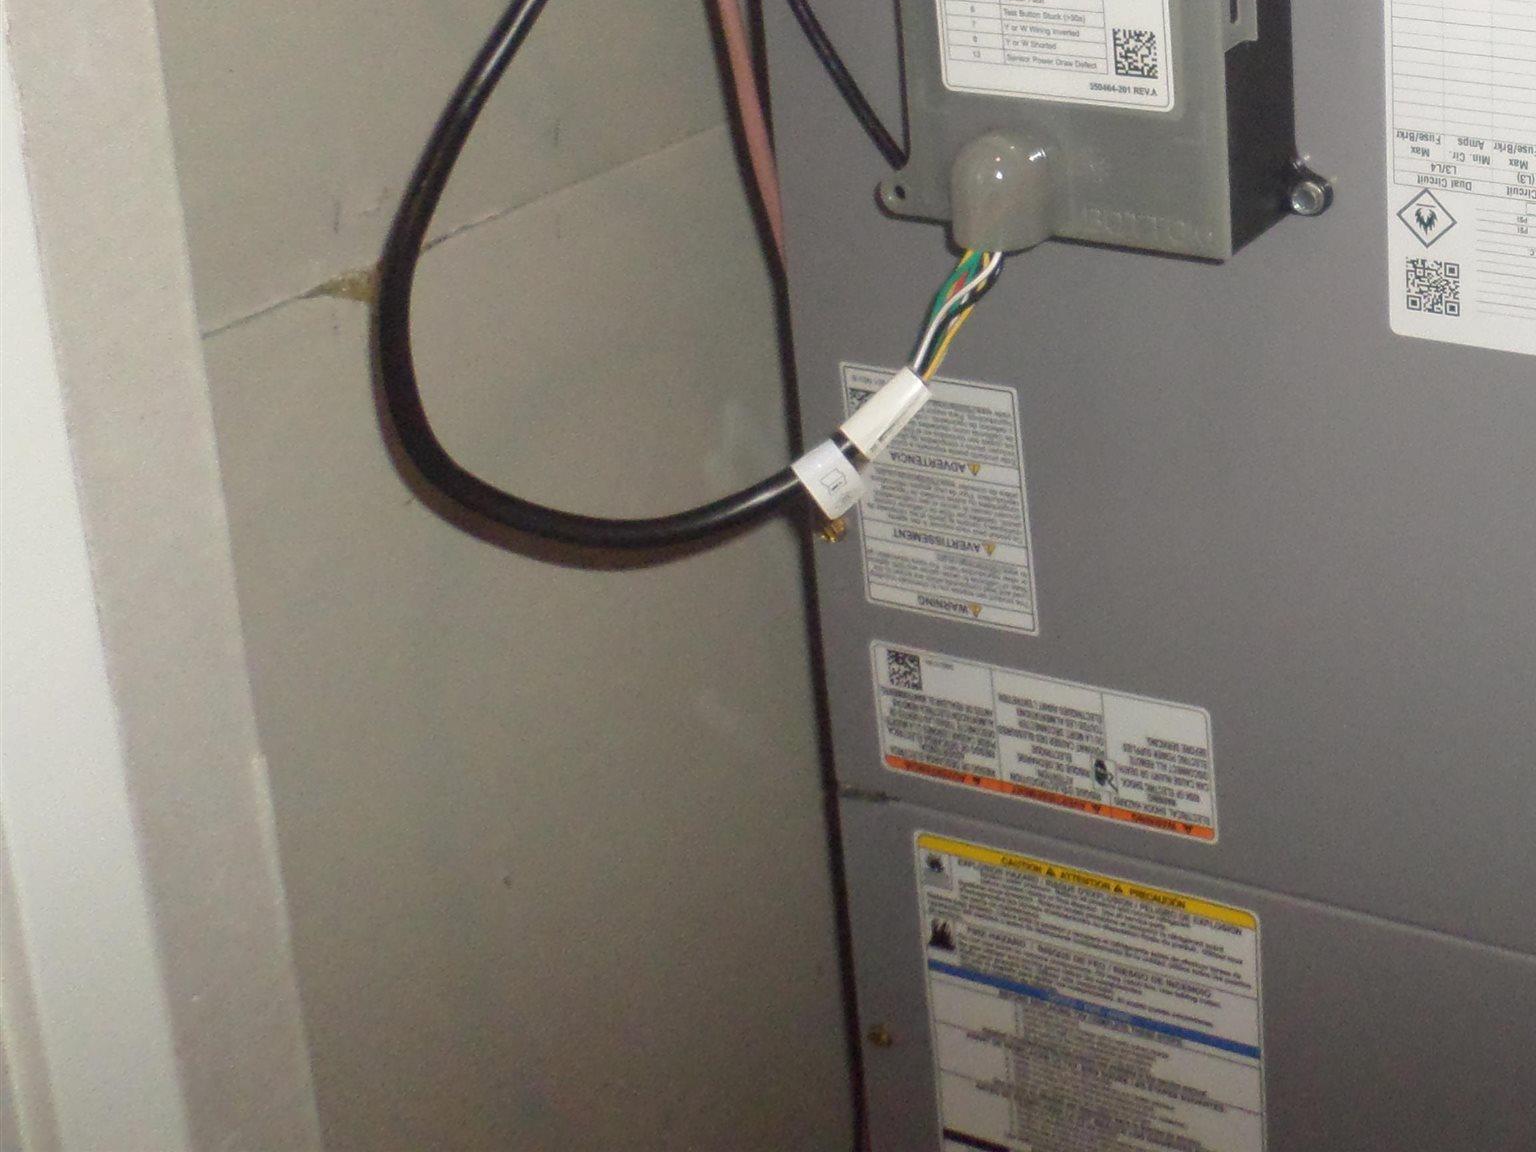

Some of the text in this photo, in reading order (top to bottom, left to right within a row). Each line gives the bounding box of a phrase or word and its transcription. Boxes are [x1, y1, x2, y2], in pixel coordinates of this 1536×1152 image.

[1004, 8, 1062, 21] Test Button Stuck
[1028, 26, 1050, 36] Wiring
[1052, 29, 1079, 38] Inverted
[1031, 41, 1056, 50] Shorted
[1007, 54, 1030, 63] Sensor
[1033, 56, 1053, 65] Power
[1055, 58, 1072, 67] Draw
[1396, 130, 1440, 144] Fuse/Brkr
[1457, 137, 1484, 151] Amps
[1410, 146, 1430, 158] Max
[1449, 151, 1490, 165] Min. Cir.
[1431, 163, 1456, 175] L3/L4
[1508, 158, 1528, 170] Max
[1417, 175, 1472, 191] Dual Circuit
[1517, 172, 1535, 184] (L3)
[1506, 187, 1536, 199] Circuit
[892, 528, 981, 554] AVERTISSEMENT
[917, 595, 968, 615] WARNING
